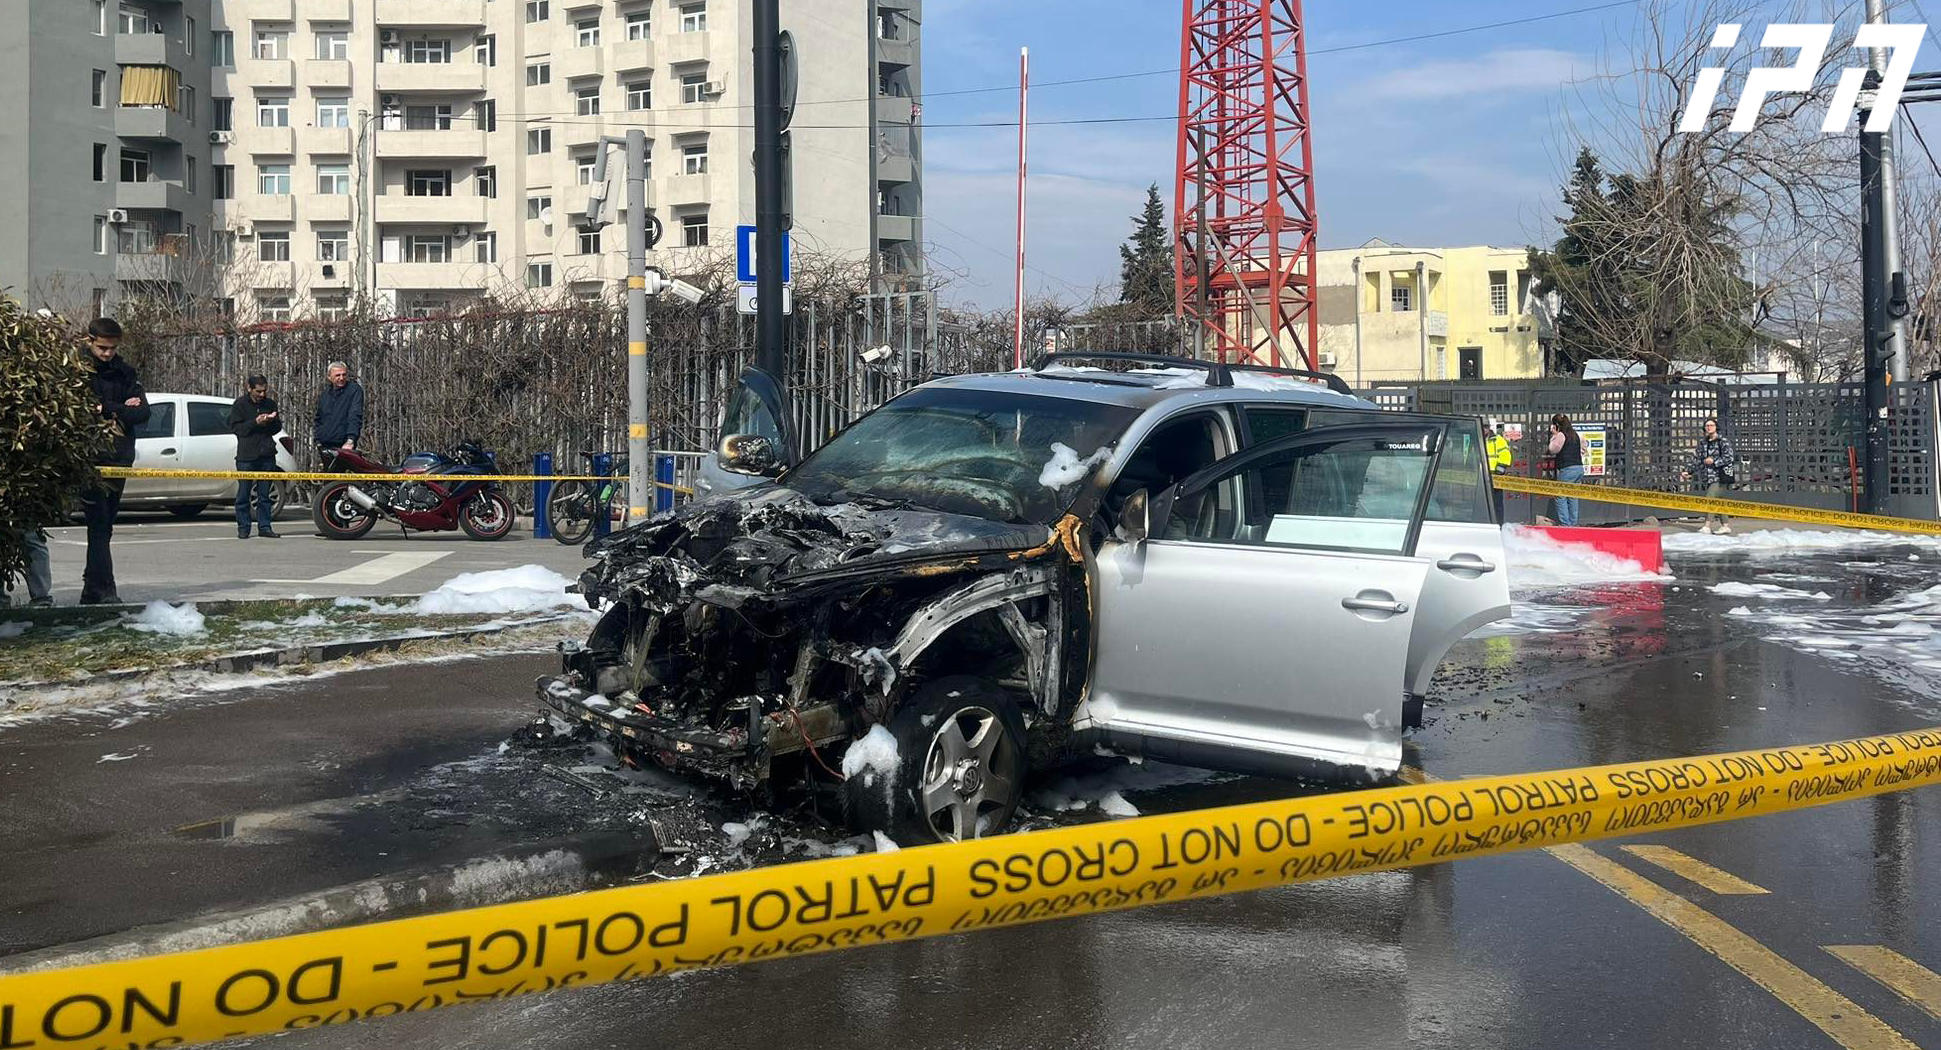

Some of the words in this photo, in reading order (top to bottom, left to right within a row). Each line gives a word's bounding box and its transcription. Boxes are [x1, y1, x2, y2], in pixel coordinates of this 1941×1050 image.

[1707, 755, 1765, 784] NOT
[1761, 751, 1804, 775] DO
[1810, 738, 1894, 766] POLICE
[1474, 777, 1599, 817] PATROL
[1609, 764, 1708, 799] CROSS
[1254, 813, 1311, 853] DO
[1343, 792, 1474, 839] POLICE
[1151, 823, 1241, 871] NOT
[970, 839, 1139, 899] CROSS
[711, 866, 936, 937] PATROL
[423, 903, 690, 986] POLICE
[214, 956, 344, 1017] DO
